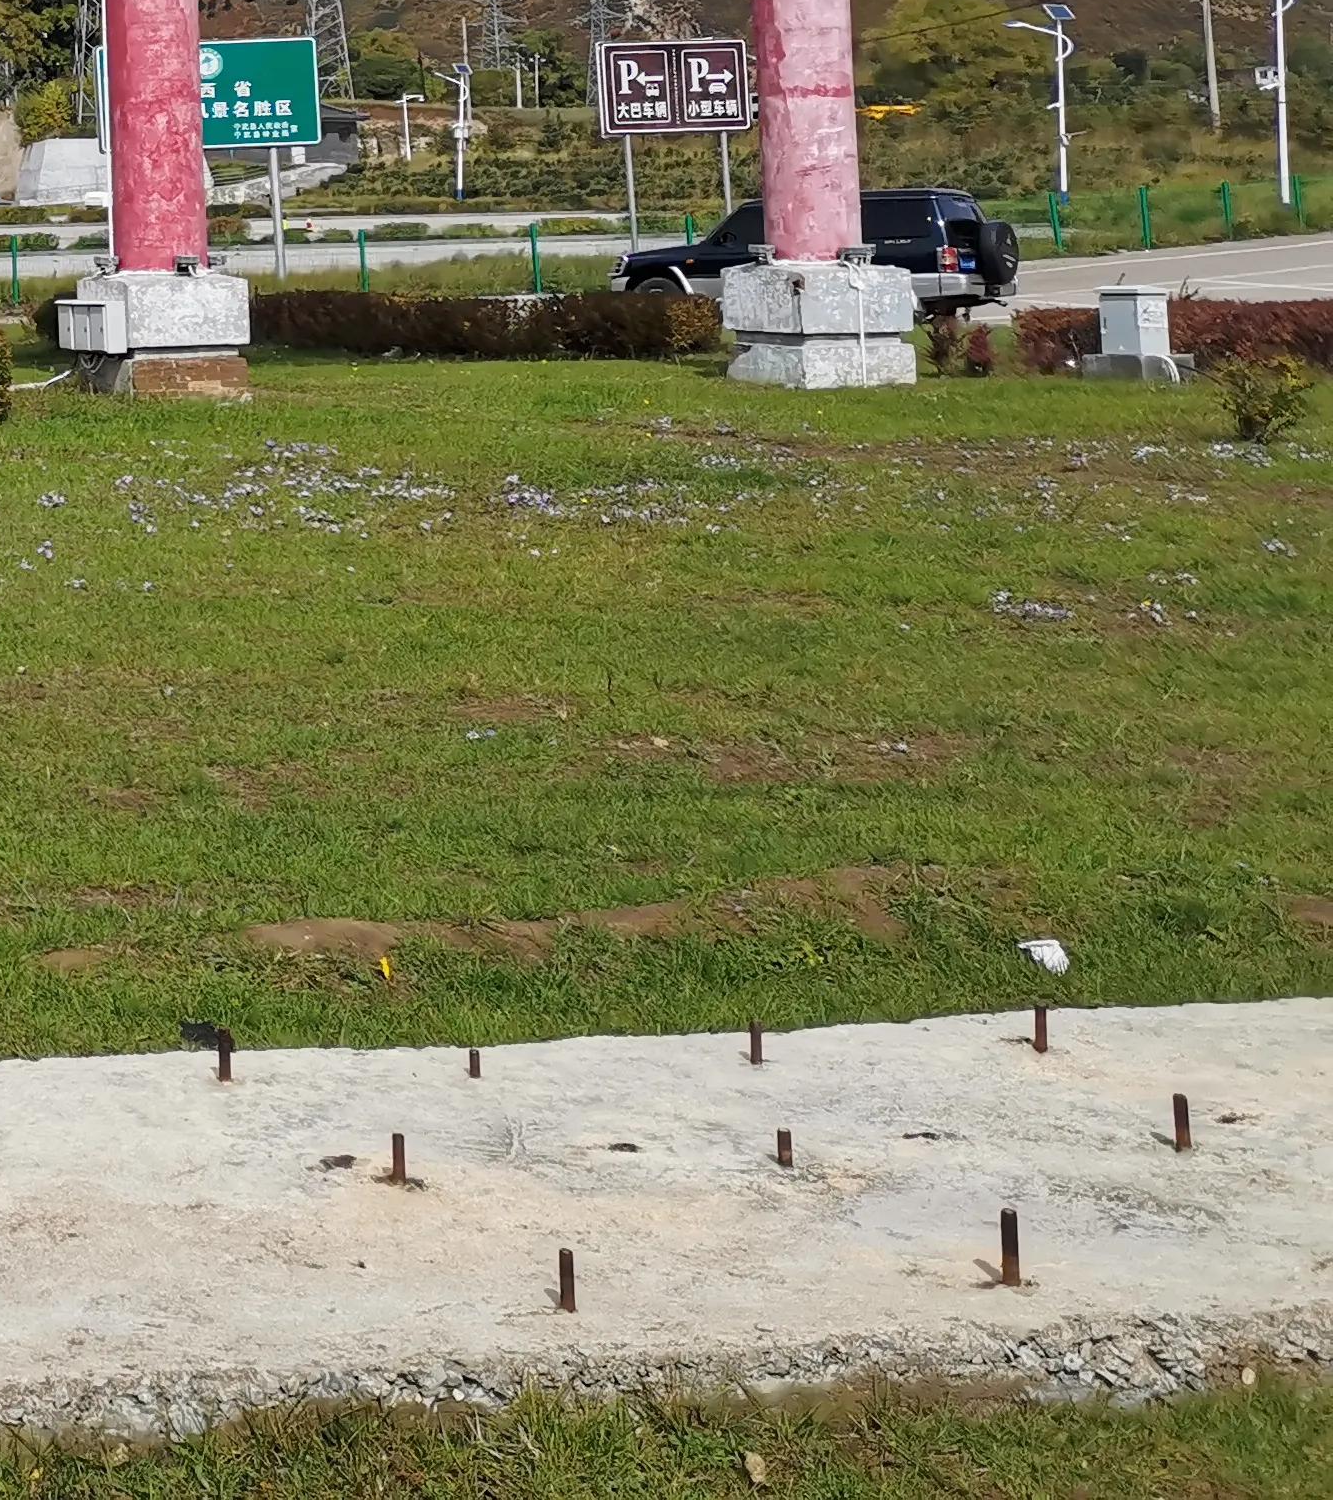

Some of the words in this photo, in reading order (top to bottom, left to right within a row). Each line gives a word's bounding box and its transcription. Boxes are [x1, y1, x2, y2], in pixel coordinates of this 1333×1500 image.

[617, 60, 639, 95] P
[687, 58, 709, 92] P
[618, 101, 667, 118] 大巴车辆
[688, 100, 737, 117] 小型车辆
